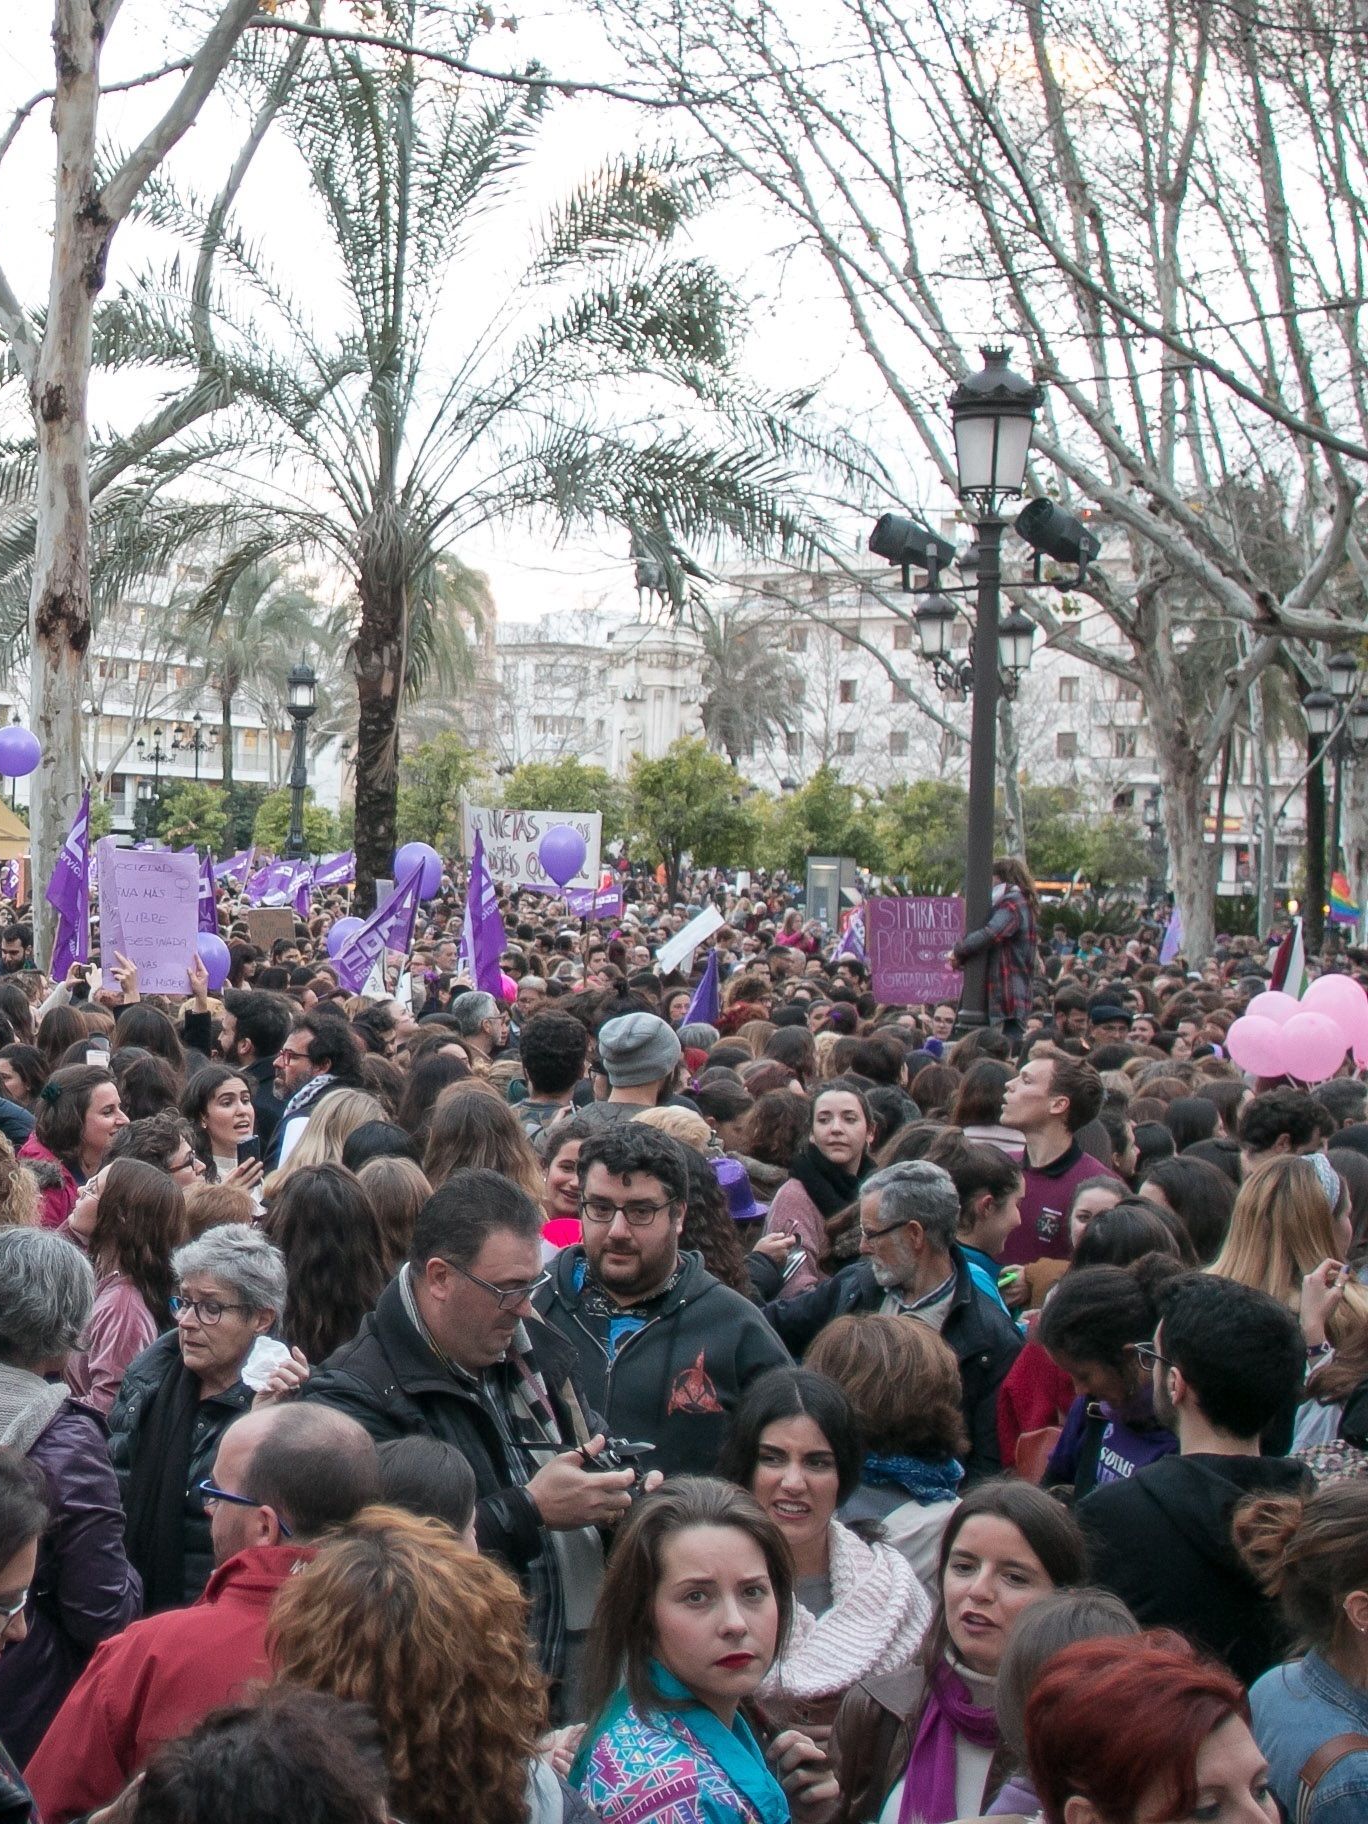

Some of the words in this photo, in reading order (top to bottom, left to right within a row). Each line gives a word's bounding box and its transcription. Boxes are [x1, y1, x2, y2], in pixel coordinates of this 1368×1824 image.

[124, 911, 169, 925] LIBRE
[878, 899, 902, 930] SI
[126, 937, 188, 949] SESINADA
[877, 930, 915, 968] POR
